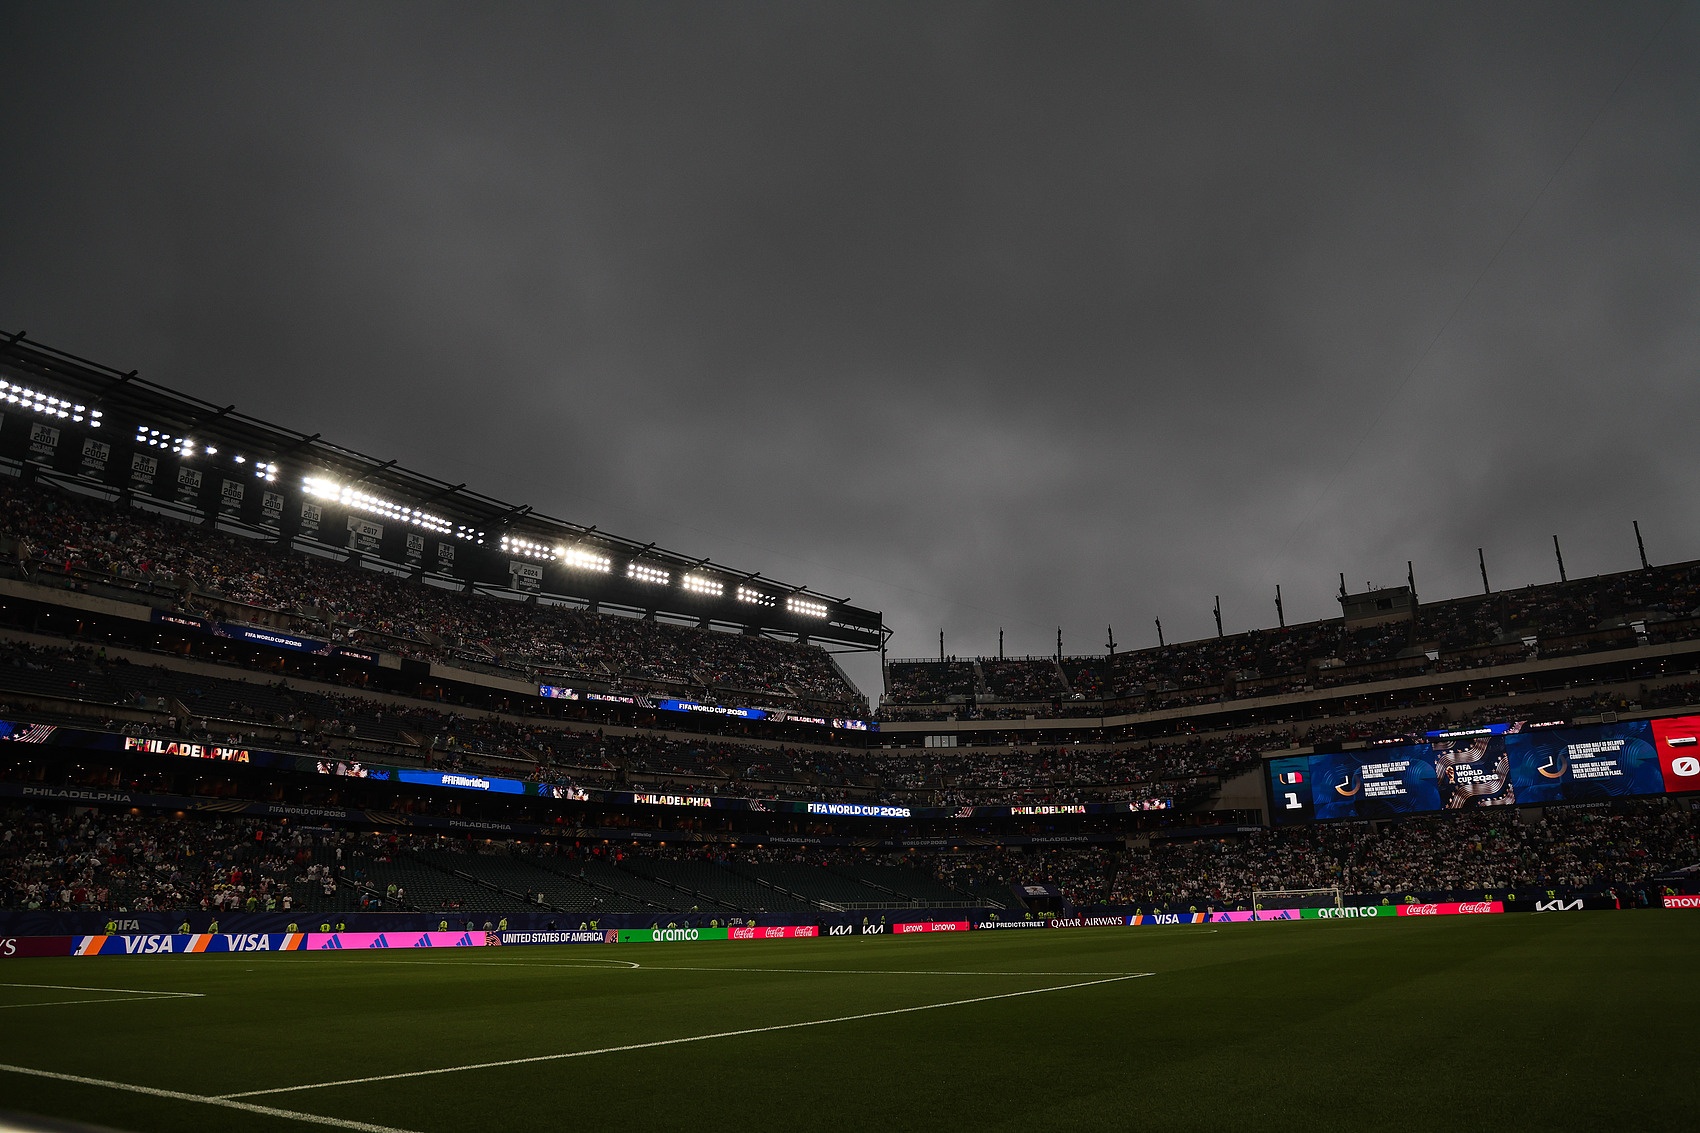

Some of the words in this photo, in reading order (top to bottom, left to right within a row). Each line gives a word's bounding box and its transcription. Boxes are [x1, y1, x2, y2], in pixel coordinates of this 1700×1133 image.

[34, 432, 55, 446] 2001
[84, 447, 107, 461] 2002
[133, 462, 155, 474] 2003
[179, 475, 199, 487] 2004
[264, 499, 281, 510] 2010
[303, 510, 319, 521] 2013
[363, 526, 378, 536] 2017
[523, 568, 538, 577] 2024
[245, 631, 256, 639] FIFA
[256, 633, 274, 642] WORLD
[274, 637, 285, 645] CUP
[285, 639, 302, 648] 2026
[587, 693, 634, 704] PHILADELPHIA
[679, 703, 692, 711] FIFA
[692, 704, 714, 713] WORLD
[714, 706, 727, 714] CUP
[124, 736, 250, 763] PHILADELPHIA
[1671, 756, 1700, 776] 0
[1456, 769, 1483, 777] WORLD
[1472, 773, 1499, 782] 2026
[441, 774, 490, 790] #FIFAWorldCup
[22, 786, 131, 803] PHILADELPHIA
[633, 793, 712, 808] PHILADELPHIA
[1284, 792, 1303, 810] 1
[269, 805, 284, 813] FIFA
[284, 807, 309, 816] WORLD
[323, 810, 347, 818] 2026
[807, 803, 828, 814] FIFA
[828, 804, 861, 815] WORLD
[862, 806, 880, 816] CUP
[880, 807, 912, 818] 2026
[1011, 804, 1086, 815] PHILADELPHIA
[449, 820, 512, 830] PHILADELPHIA
[1535, 899, 1584, 911] KIA
[1317, 906, 1378, 919] aramco
[1051, 918, 1082, 928] QATAR
[1084, 916, 1123, 927] AIRWAYS
[1152, 914, 1179, 924] VISA
[829, 925, 853, 936] KIA
[862, 924, 884, 935] KIA
[902, 924, 924, 933] Lenovo
[931, 922, 956, 932] Lenovo
[979, 921, 996, 930] ADI
[502, 933, 531, 944] UNITED
[531, 932, 560, 943] STATES
[560, 932, 571, 942] OF
[571, 931, 604, 942] AMERICA
[652, 928, 699, 941] aramco
[120, 935, 173, 954] VISA
[223, 934, 270, 951] VISA
